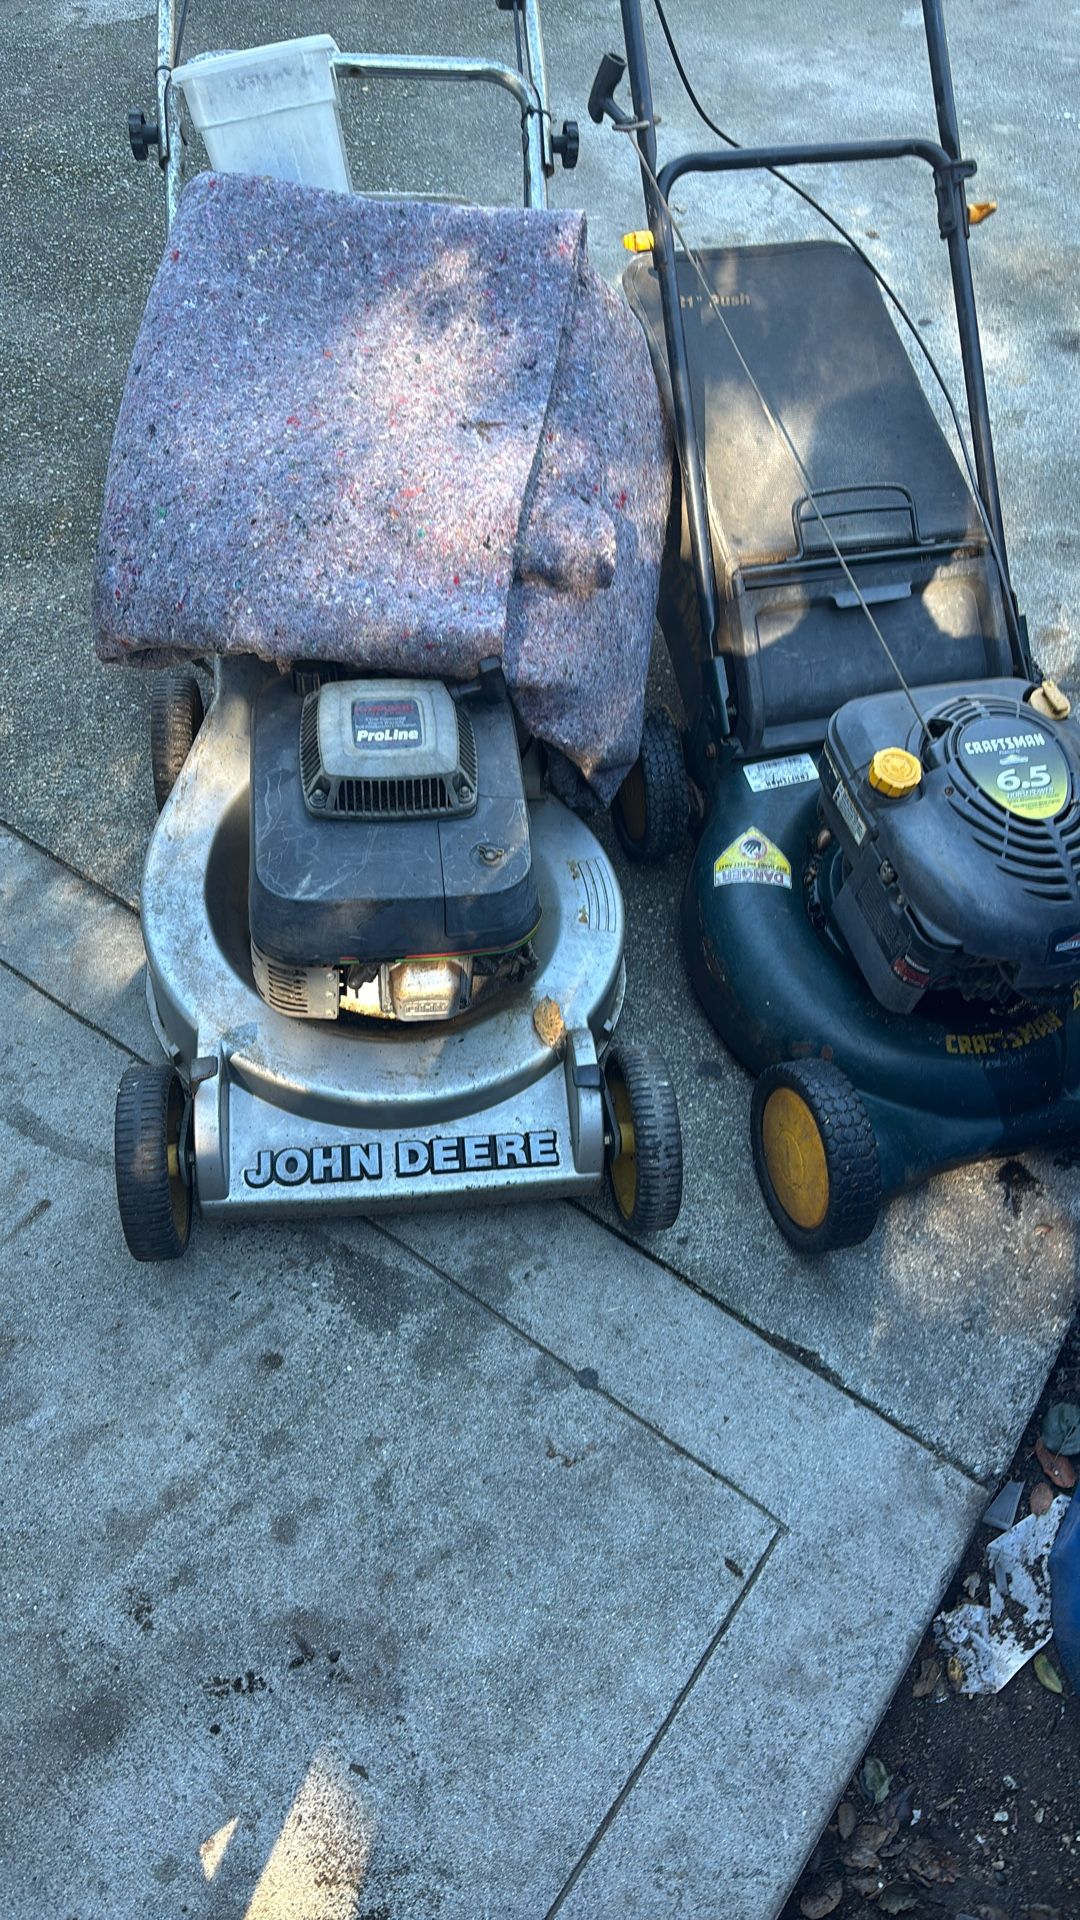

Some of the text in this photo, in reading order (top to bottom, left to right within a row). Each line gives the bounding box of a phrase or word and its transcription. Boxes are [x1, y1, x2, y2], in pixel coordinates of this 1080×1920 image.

[709, 292, 751, 309] Push
[356, 728, 419, 742] ProLine
[964, 732, 1046, 755] CRAFTSMAN
[996, 764, 1051, 792] 6.5
[722, 868, 784, 884] DANGER
[243, 1130, 560, 1189] JOHN DEERE
